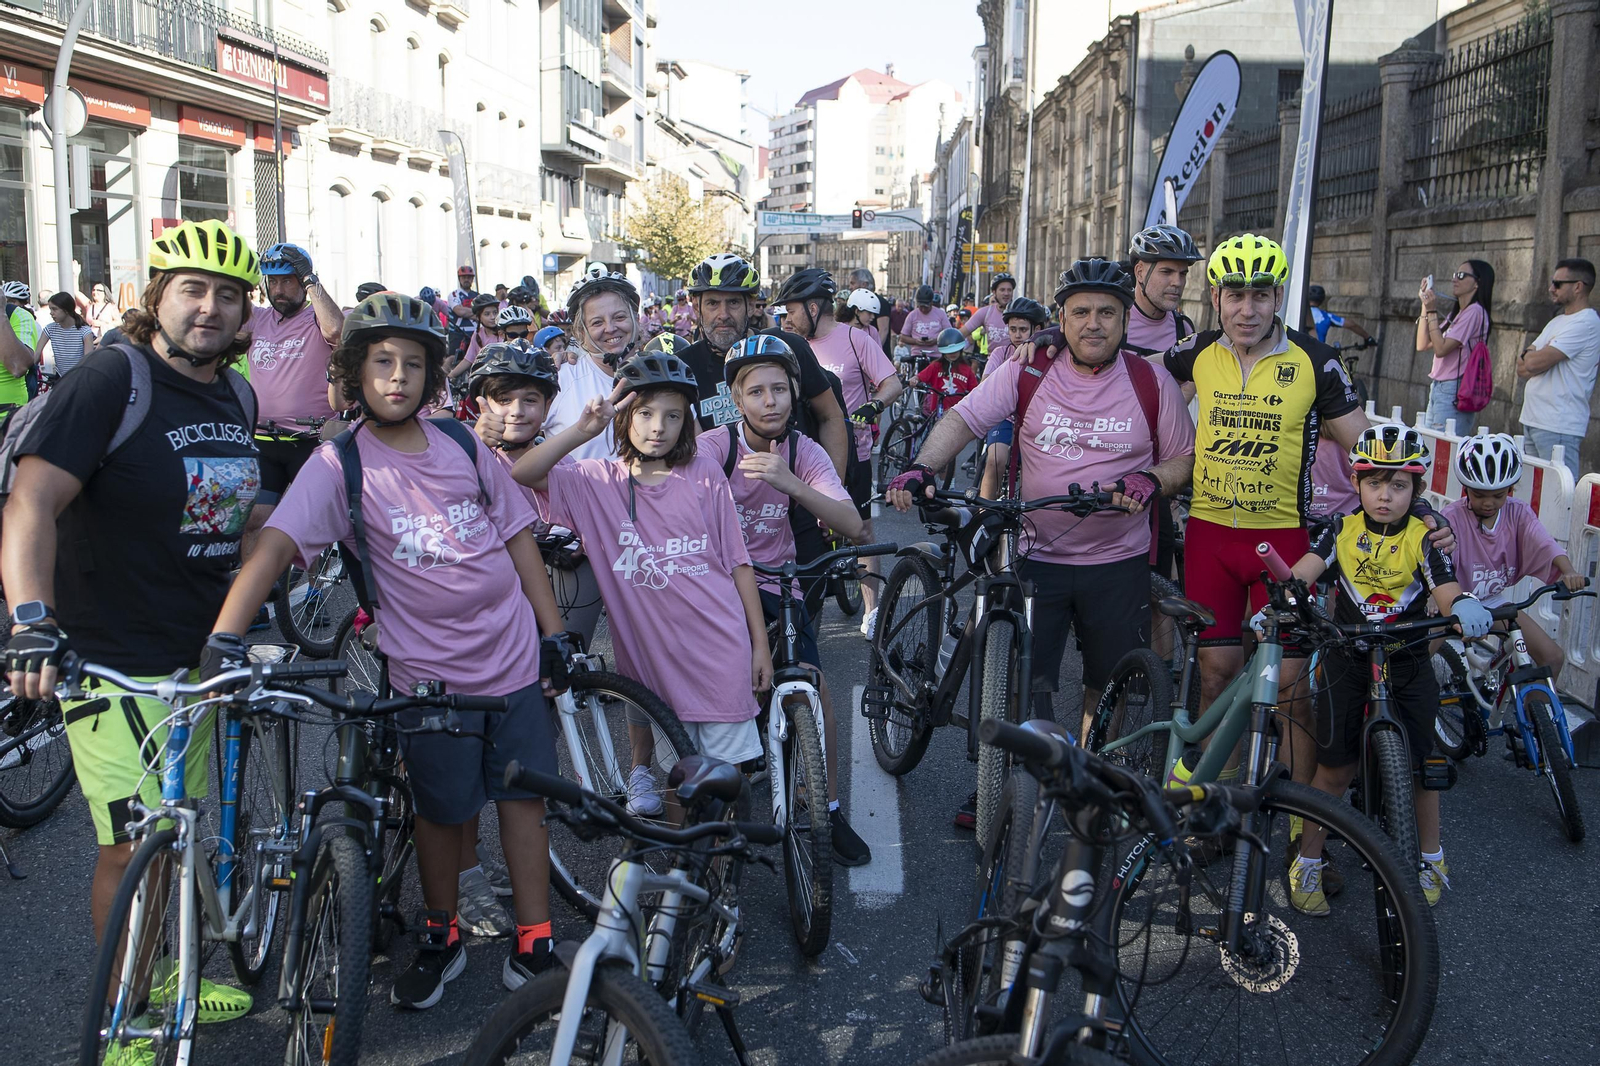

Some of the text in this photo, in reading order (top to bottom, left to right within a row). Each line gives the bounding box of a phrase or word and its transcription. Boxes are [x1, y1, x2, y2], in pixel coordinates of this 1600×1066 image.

[283, 336, 306, 348] Bici
[1213, 390, 1259, 401] Carrefour
[703, 397, 737, 414] NOR
[716, 409, 742, 422] FAC
[1041, 412, 1072, 427] Día
[1092, 416, 1133, 432] Bici
[1221, 415, 1281, 432] VALLINAS
[1213, 429, 1280, 442] SELLE
[1205, 439, 1279, 458] SMP
[1201, 490, 1233, 506] progetto
[391, 512, 427, 534] Día
[447, 500, 480, 525] Bic
[760, 503, 789, 518] Bic
[665, 533, 708, 556] Bici
[1473, 568, 1497, 582] Día
[1096, 678, 1116, 715] PYTHON
[1117, 831, 1156, 880] HUTCHIN
